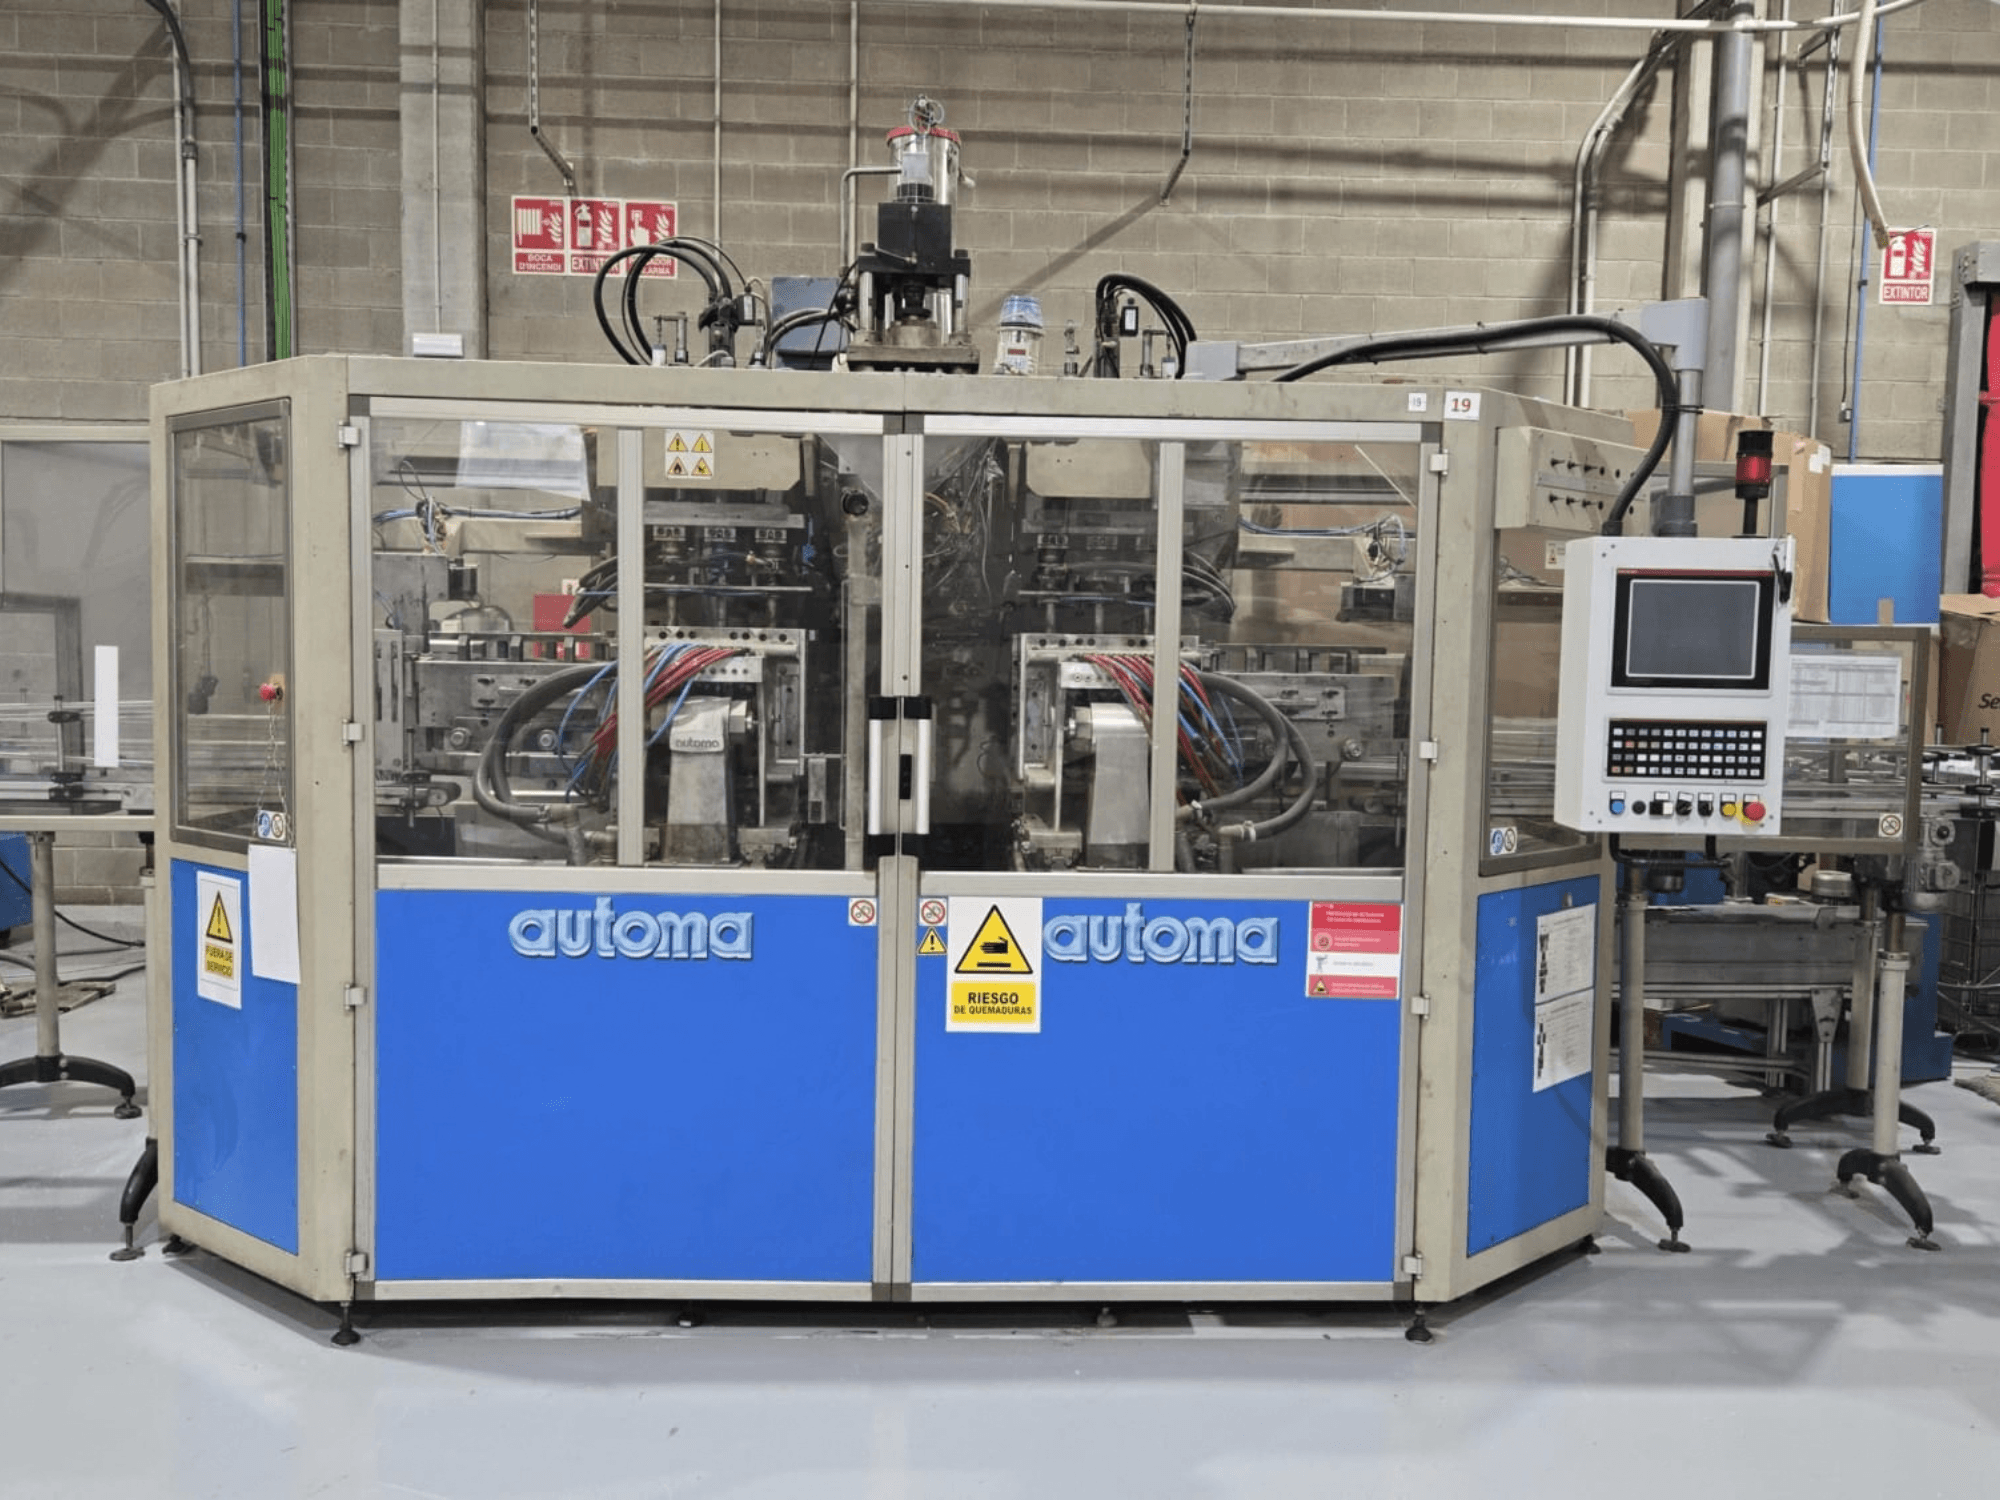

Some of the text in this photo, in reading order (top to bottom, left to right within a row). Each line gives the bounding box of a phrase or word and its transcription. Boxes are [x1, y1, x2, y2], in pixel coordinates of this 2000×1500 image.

[528, 253, 552, 262] BOCA
[1883, 286, 1929, 299] EXTINTOR
[1451, 398, 1471, 412] 19
[508, 896, 754, 959] automa
[1043, 902, 1279, 964] automa
[968, 992, 1019, 1004] RIESGO
[954, 1005, 1032, 1015] DE QUEMADURAS
